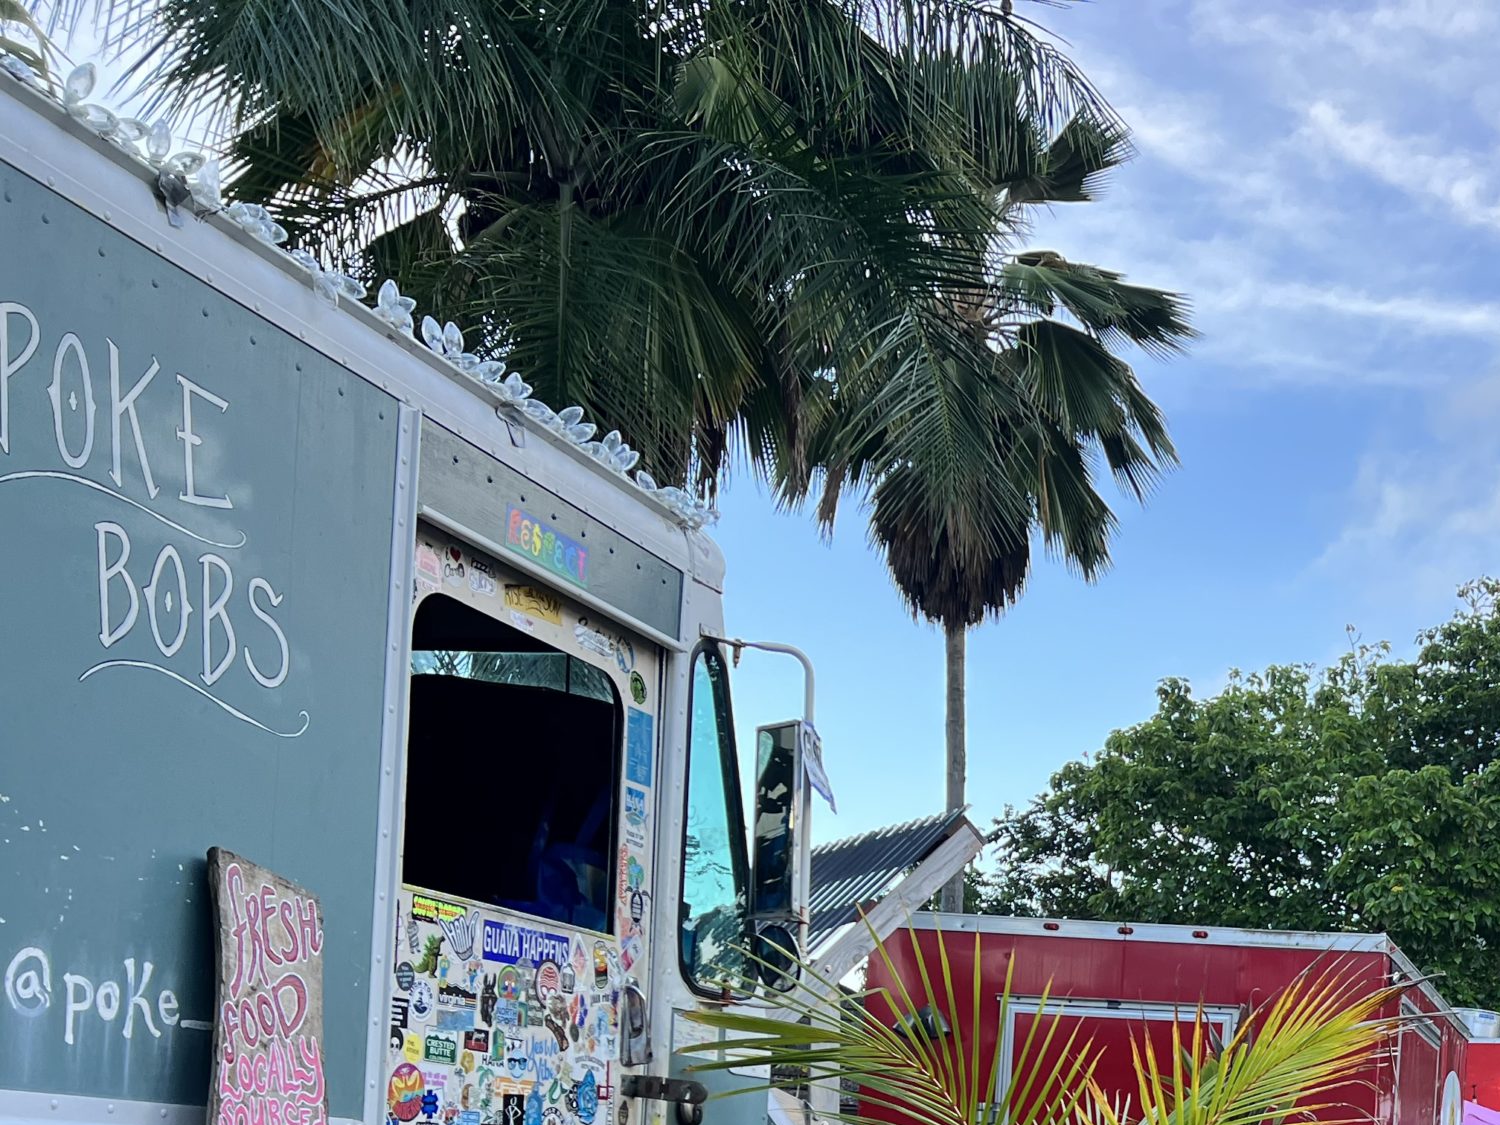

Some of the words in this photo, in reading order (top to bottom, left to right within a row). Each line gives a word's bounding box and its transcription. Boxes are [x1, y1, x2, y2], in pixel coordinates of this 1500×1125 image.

[0, 301, 234, 510] POKE
[94, 521, 290, 689] BOBS
[483, 925, 520, 957] GUAVA
[522, 933, 569, 966] HAPPENS
[5, 946, 215, 1045] @poke_
[219, 1036, 325, 1105] LOCALLY
[426, 1038, 455, 1050] CRESTED
[429, 1048, 452, 1057] BUTTE
